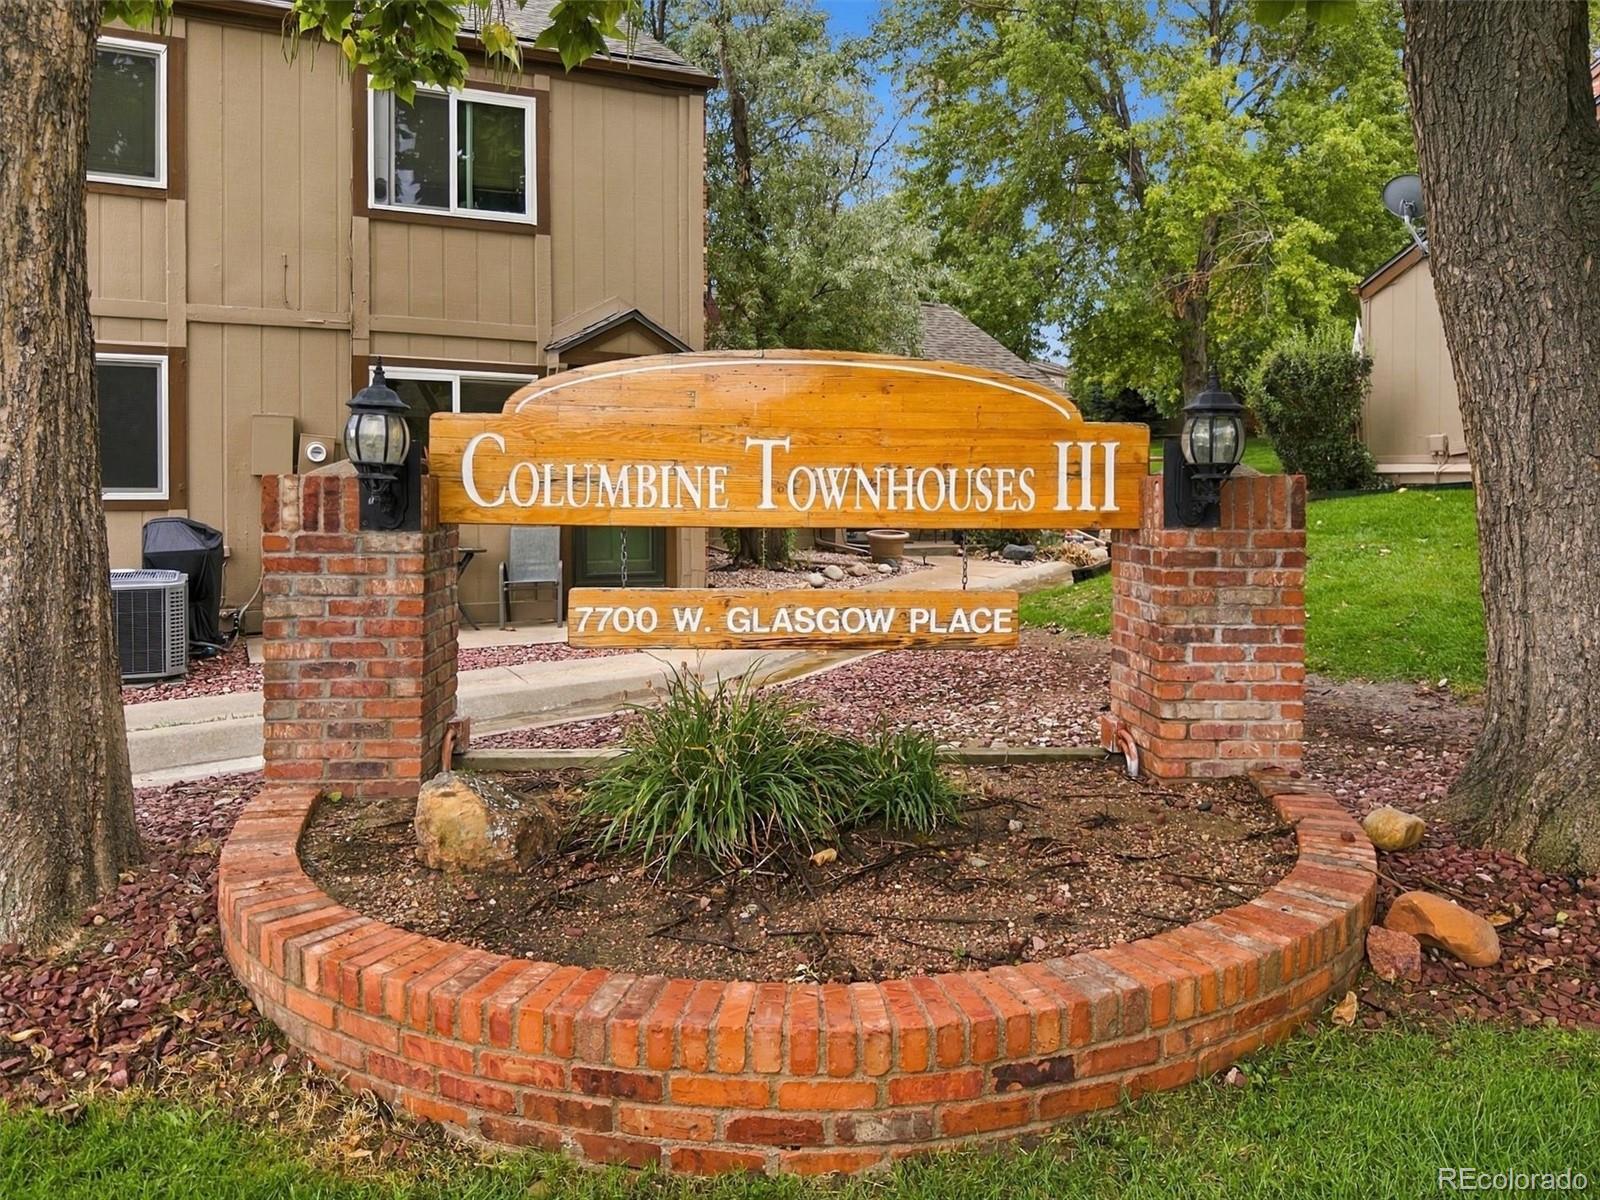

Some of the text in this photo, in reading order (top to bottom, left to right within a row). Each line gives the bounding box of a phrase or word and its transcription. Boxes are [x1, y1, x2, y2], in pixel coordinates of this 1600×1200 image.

[461, 432, 1120, 512] COLUMBINE TOWNHOUSES III
[575, 606, 1013, 634] 7700 W. GLASGOW PLACE
